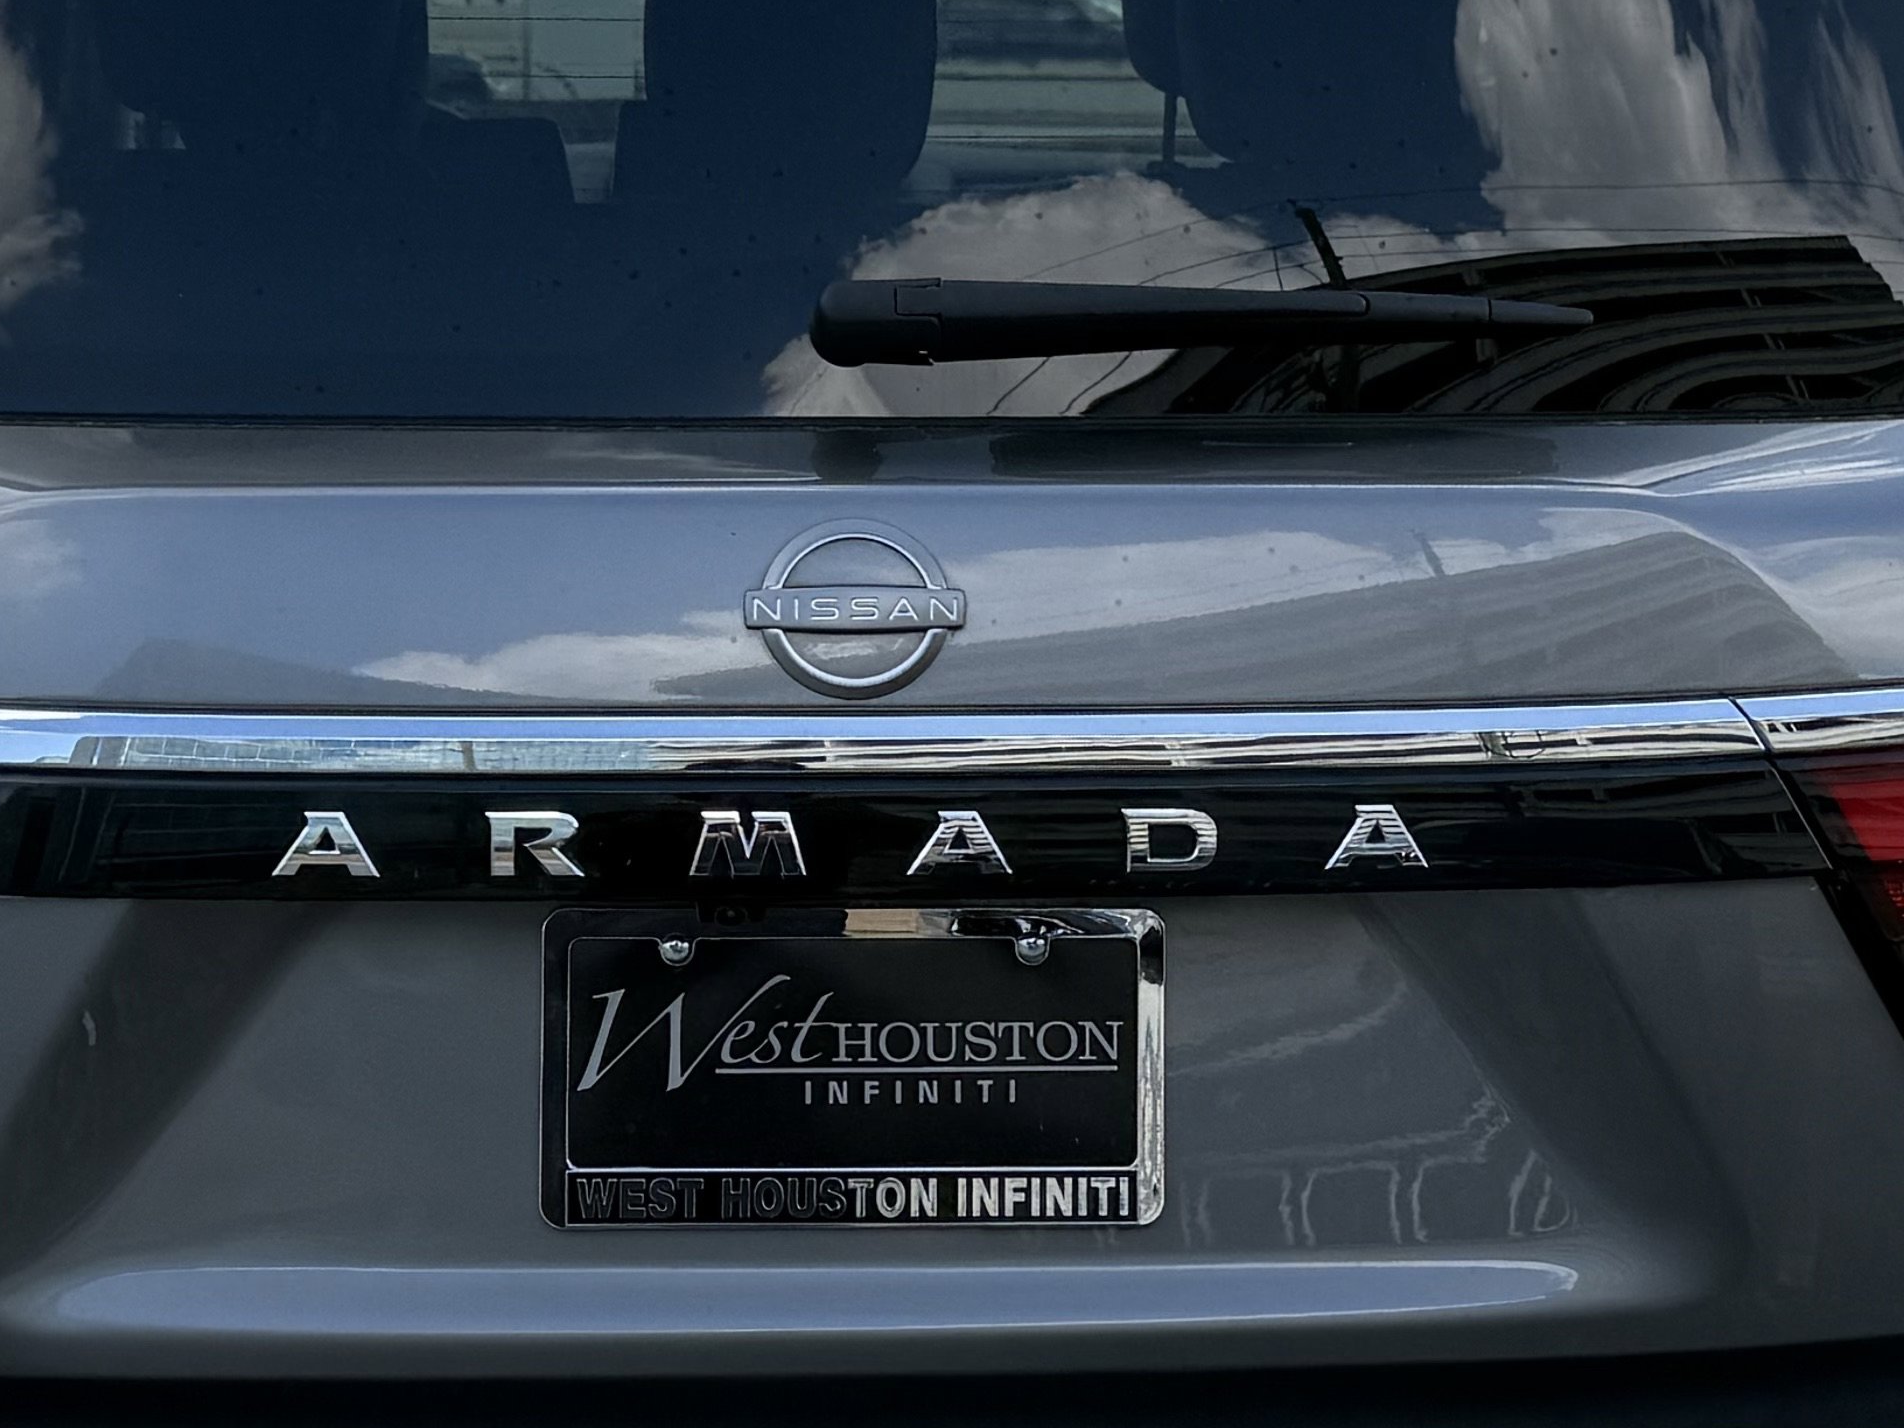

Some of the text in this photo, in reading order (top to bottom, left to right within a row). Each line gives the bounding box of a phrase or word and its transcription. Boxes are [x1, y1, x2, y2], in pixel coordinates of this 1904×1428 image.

[752, 597, 959, 622] NISSAN
[271, 803, 1430, 879] ARMADA
[576, 974, 1124, 1092] West HOUSTON
[804, 1079, 1017, 1105] INFINITI
[576, 1175, 1130, 1220] WEST HOUSTON INFINITI
